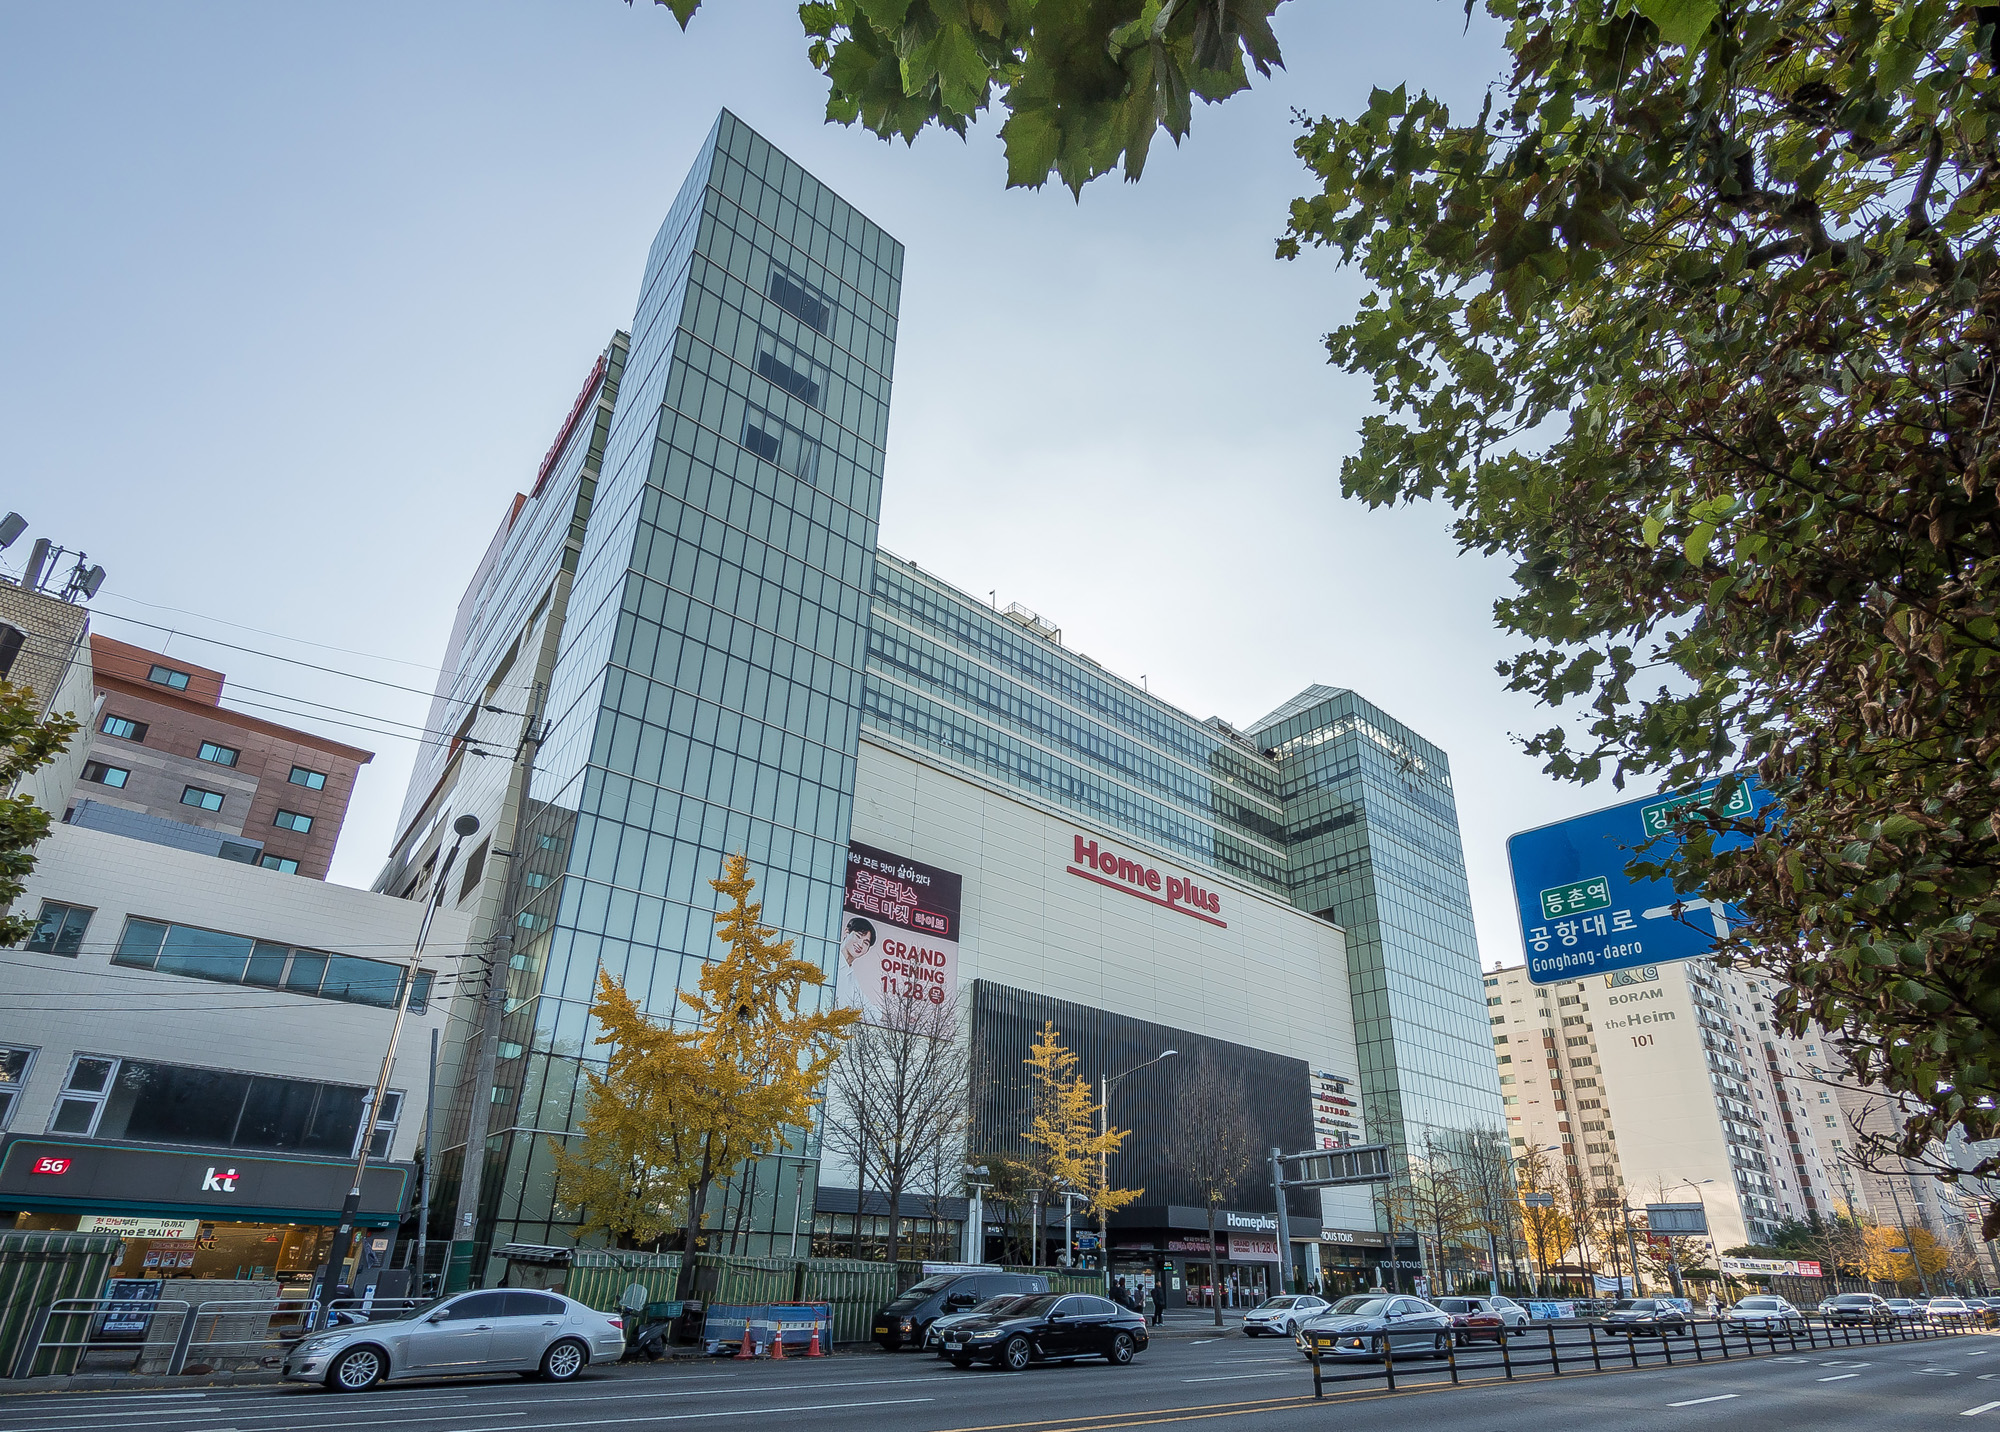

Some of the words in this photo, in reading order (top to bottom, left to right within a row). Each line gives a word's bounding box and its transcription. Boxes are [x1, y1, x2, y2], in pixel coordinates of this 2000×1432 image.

[863, 857, 879, 870] 모든
[880, 862, 896, 876] 맛이
[1074, 834, 1161, 891] Home
[1166, 875, 1221, 914] plus
[856, 870, 918, 905] 홈플러스
[1545, 882, 1607, 913] 등촌역
[915, 912, 945, 930] 라이브
[1528, 909, 1638, 952] 공항대로
[882, 939, 946, 967] GRAND
[1532, 941, 1643, 973] Gonghang-daero
[881, 958, 945, 985] OPENING
[1608, 988, 1664, 1006] BORAM
[1630, 1034, 1654, 1047] 101
[40, 1159, 64, 1172] 5G
[201, 1167, 240, 1192] kt
[95, 1217, 104, 1225] 첫
[105, 1218, 139, 1226] 만남부터
[161, 1220, 186, 1228] 16까지
[1227, 1212, 1276, 1231] Homeplus
[166, 1229, 183, 1237] KT
[194, 1234, 219, 1250] kt
[1338, 1232, 1353, 1242] TOUS
[1401, 1260, 1422, 1269] TOUS
